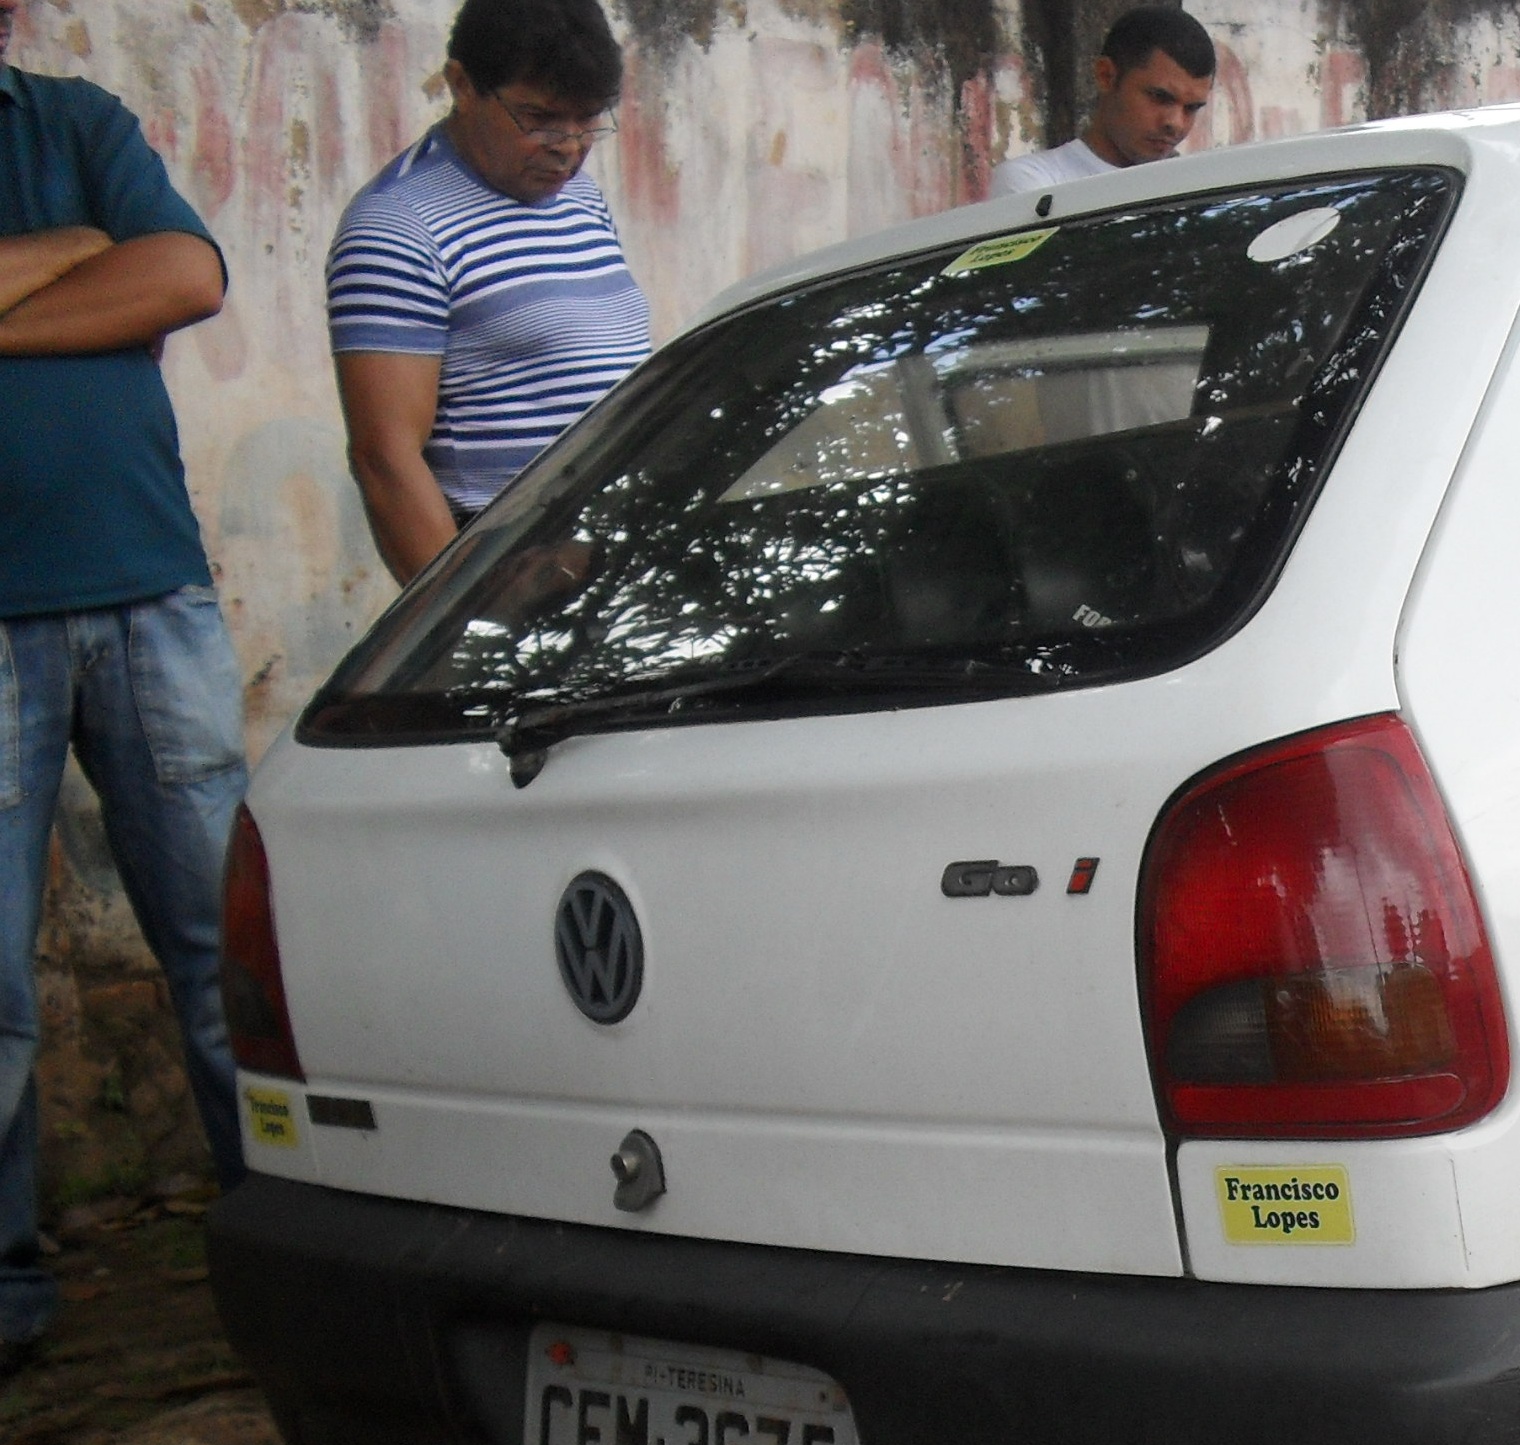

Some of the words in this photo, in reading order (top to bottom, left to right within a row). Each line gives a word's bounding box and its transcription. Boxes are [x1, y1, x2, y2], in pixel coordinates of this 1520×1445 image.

[1066, 857, 1100, 894] i
[557, 871, 642, 1020] VW
[1224, 1177, 1340, 1201] Francisco
[1250, 1205, 1320, 1234] Lopes
